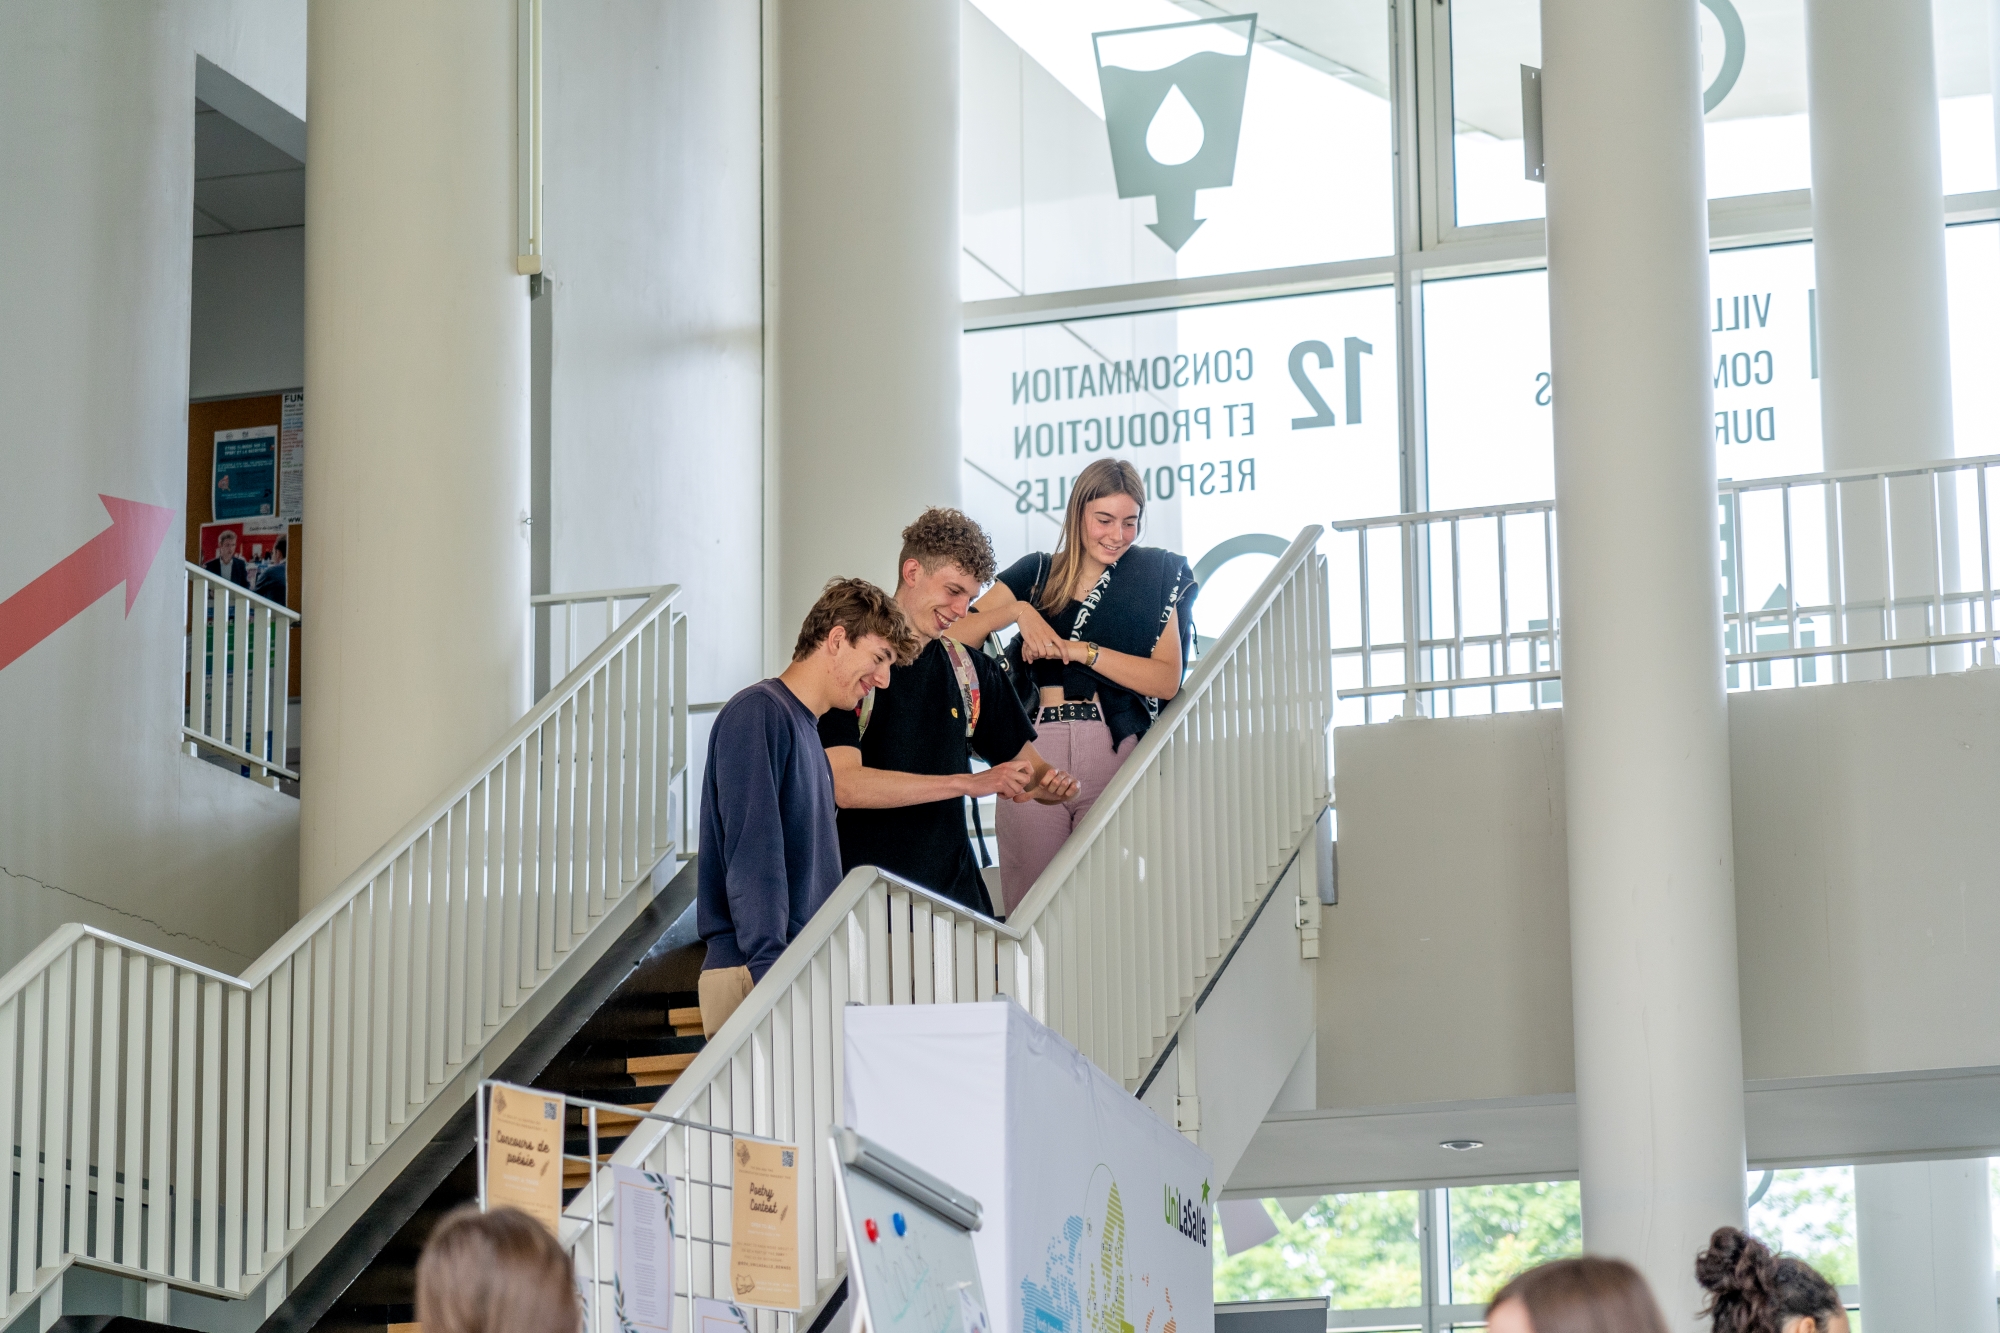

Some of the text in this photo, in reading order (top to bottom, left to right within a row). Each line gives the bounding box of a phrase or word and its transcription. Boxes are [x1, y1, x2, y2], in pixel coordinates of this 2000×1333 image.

[495, 1129, 551, 1154] Concours de
[505, 1151, 536, 1168] poésie
[749, 1182, 774, 1202] Poetry
[749, 1198, 778, 1214] Contest
[1164, 1182, 1207, 1248] UniLaSalle
